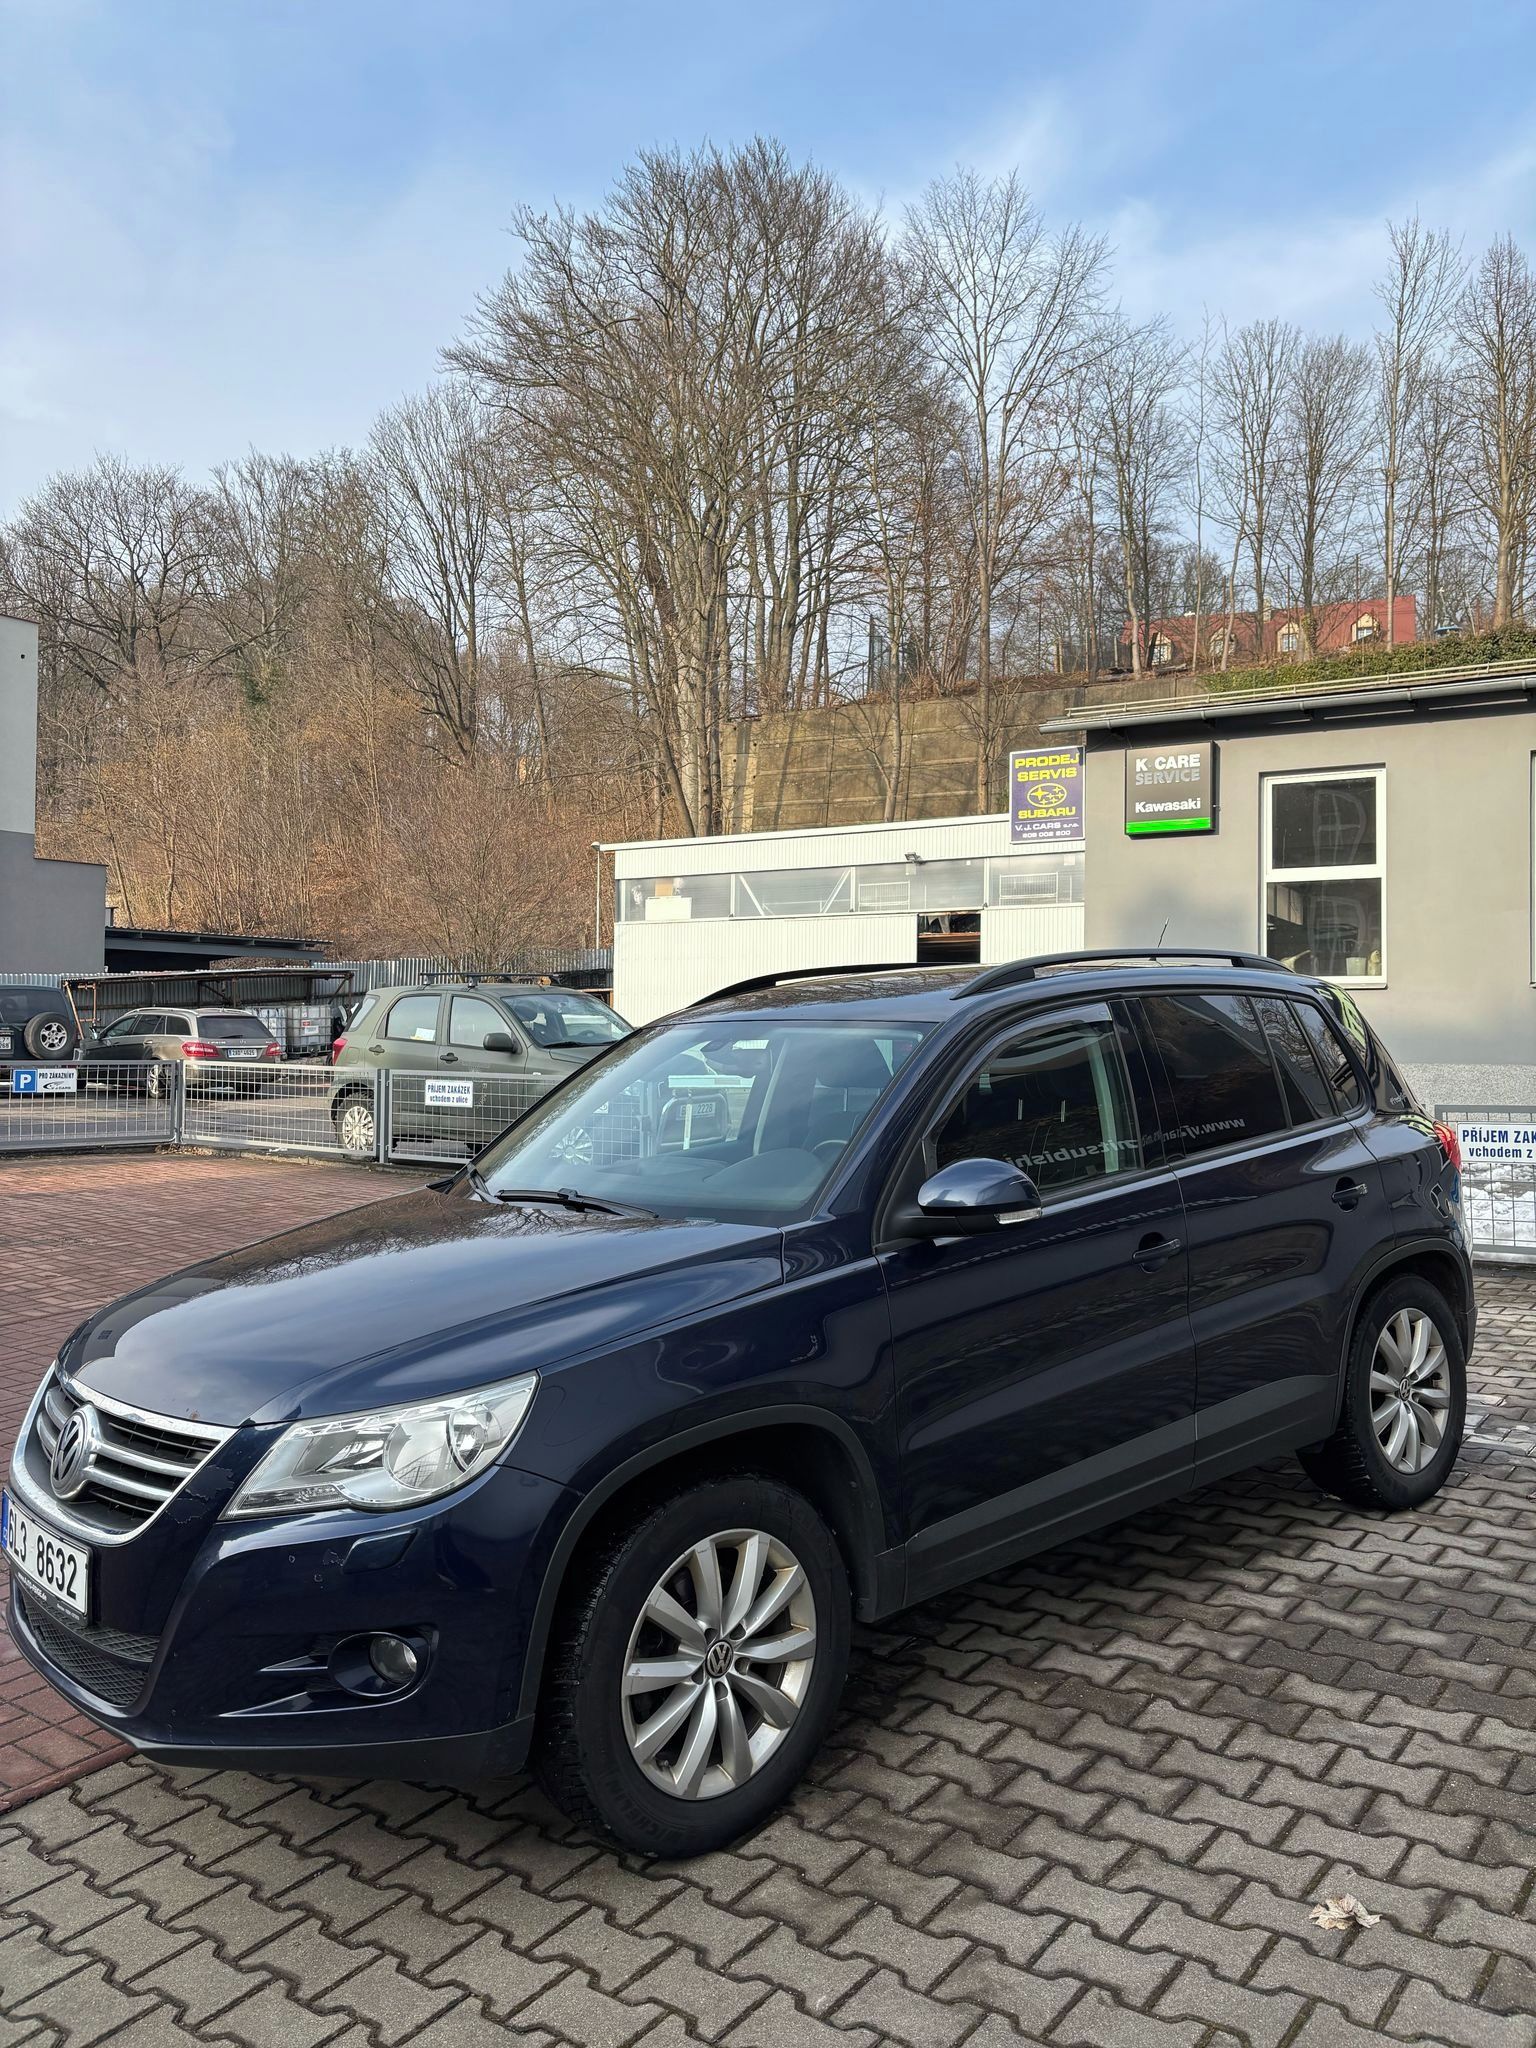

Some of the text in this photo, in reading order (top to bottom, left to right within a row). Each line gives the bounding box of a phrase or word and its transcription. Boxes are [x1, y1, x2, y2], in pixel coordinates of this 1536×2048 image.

[1014, 753, 1080, 769] PRODEJ
[1017, 767, 1078, 782] SERVIS
[1135, 768, 1201, 786] SERVICE
[1018, 806, 1076, 819] SUBARU
[1135, 798, 1201, 814] Kawasaki
[1032, 822, 1061, 830] CARS
[20, 1074, 32, 1089] P
[447, 1084, 471, 1095] ZAKÁZEK
[1462, 1126, 1509, 1144] PŘÍJEM
[1468, 1146, 1533, 1158] vchodem z
[9, 1508, 27, 1562] 6L3
[37, 1534, 78, 1601] 8632
